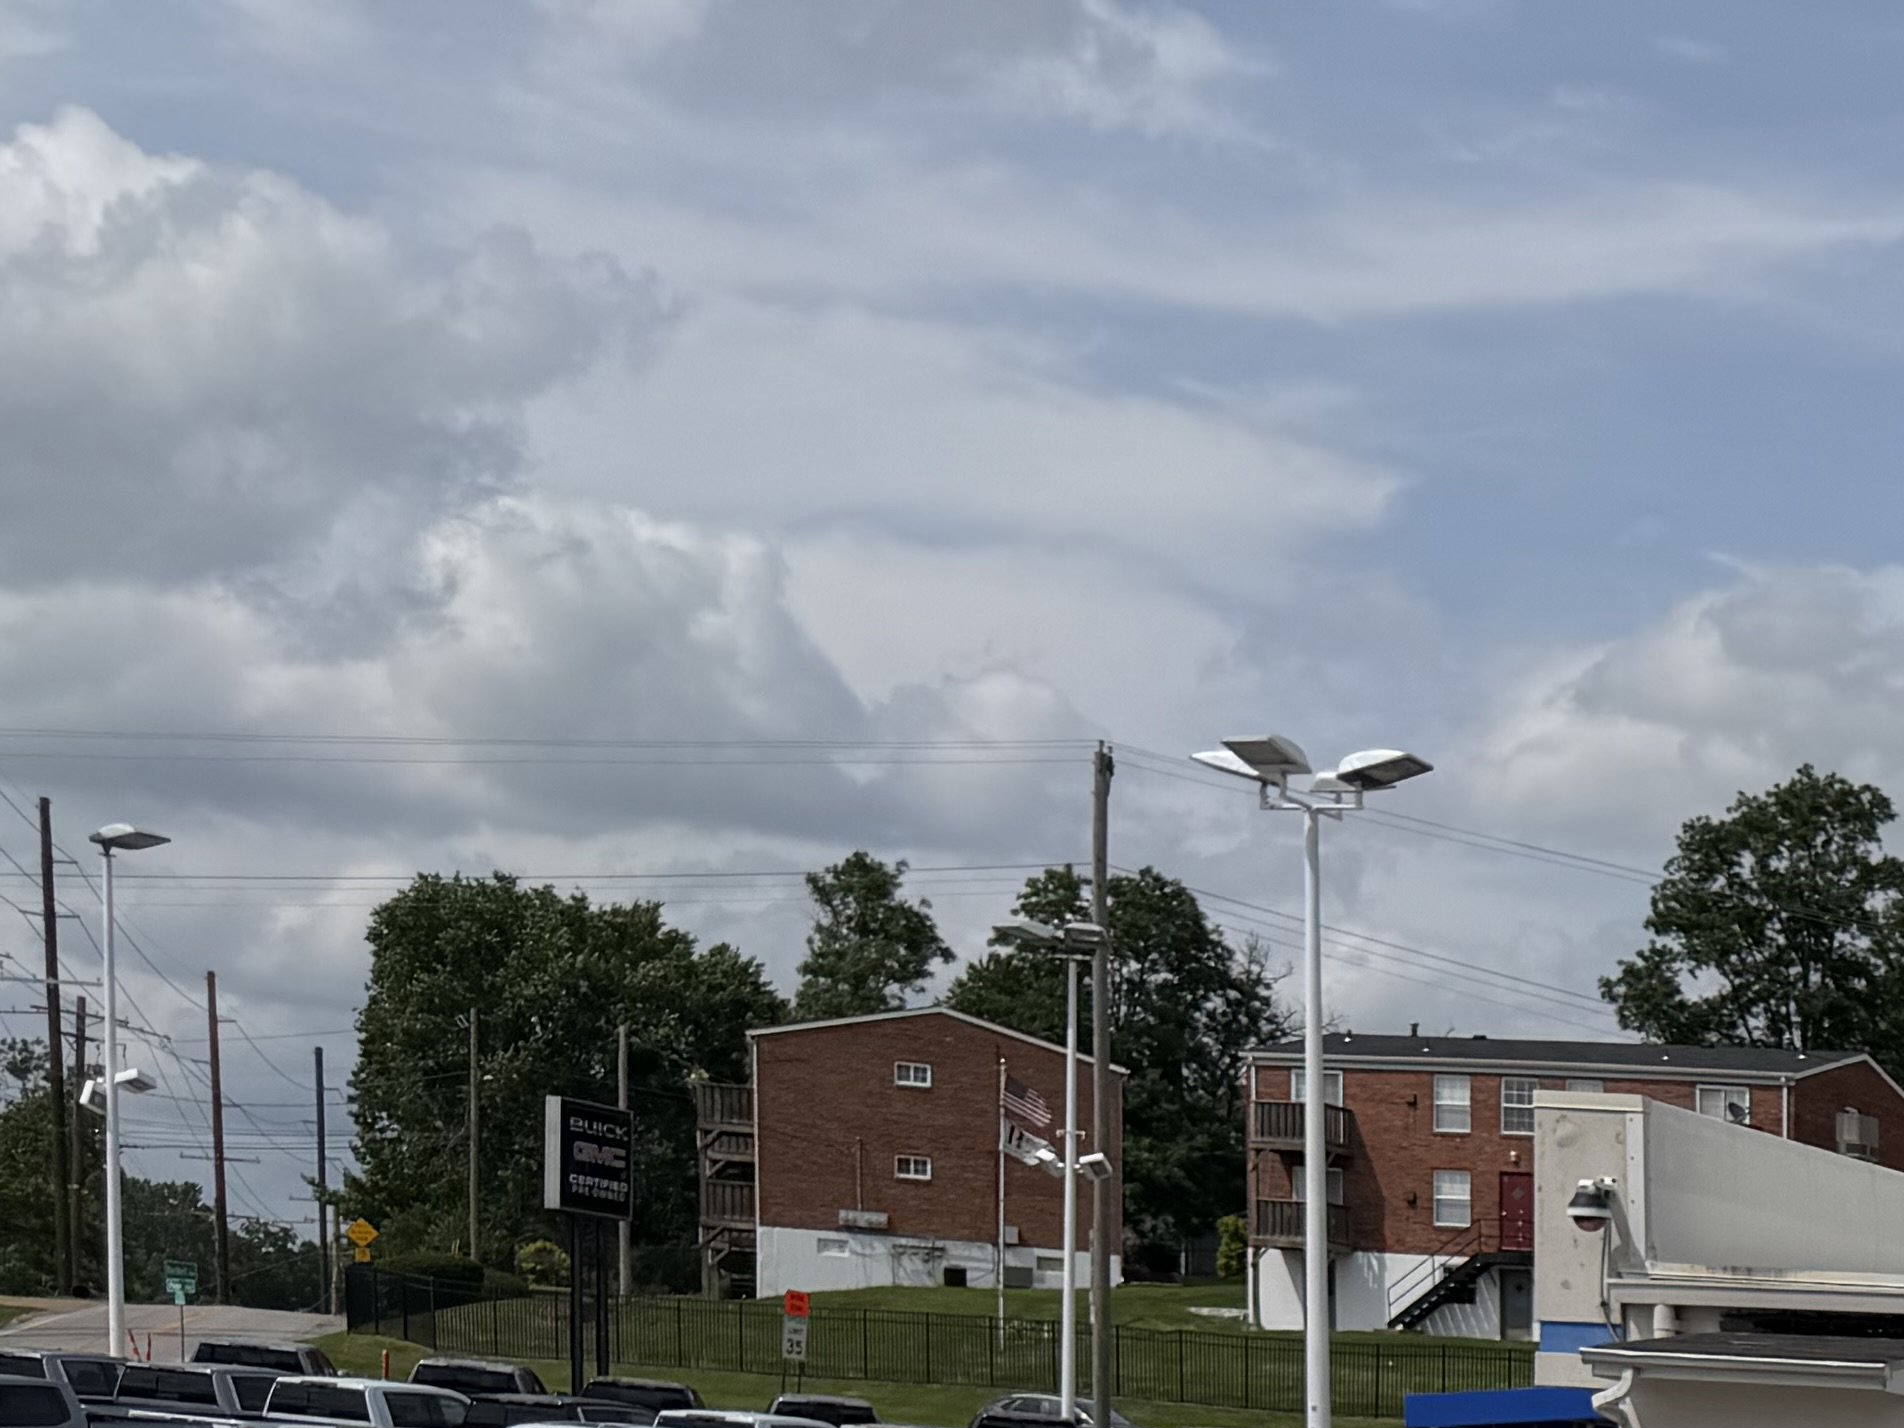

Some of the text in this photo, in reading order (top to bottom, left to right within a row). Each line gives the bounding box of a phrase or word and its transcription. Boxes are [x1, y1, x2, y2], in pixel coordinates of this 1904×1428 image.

[569, 1116, 629, 1142] BUICK
[573, 1140, 626, 1168] GMC
[786, 1338, 803, 1355] 35
